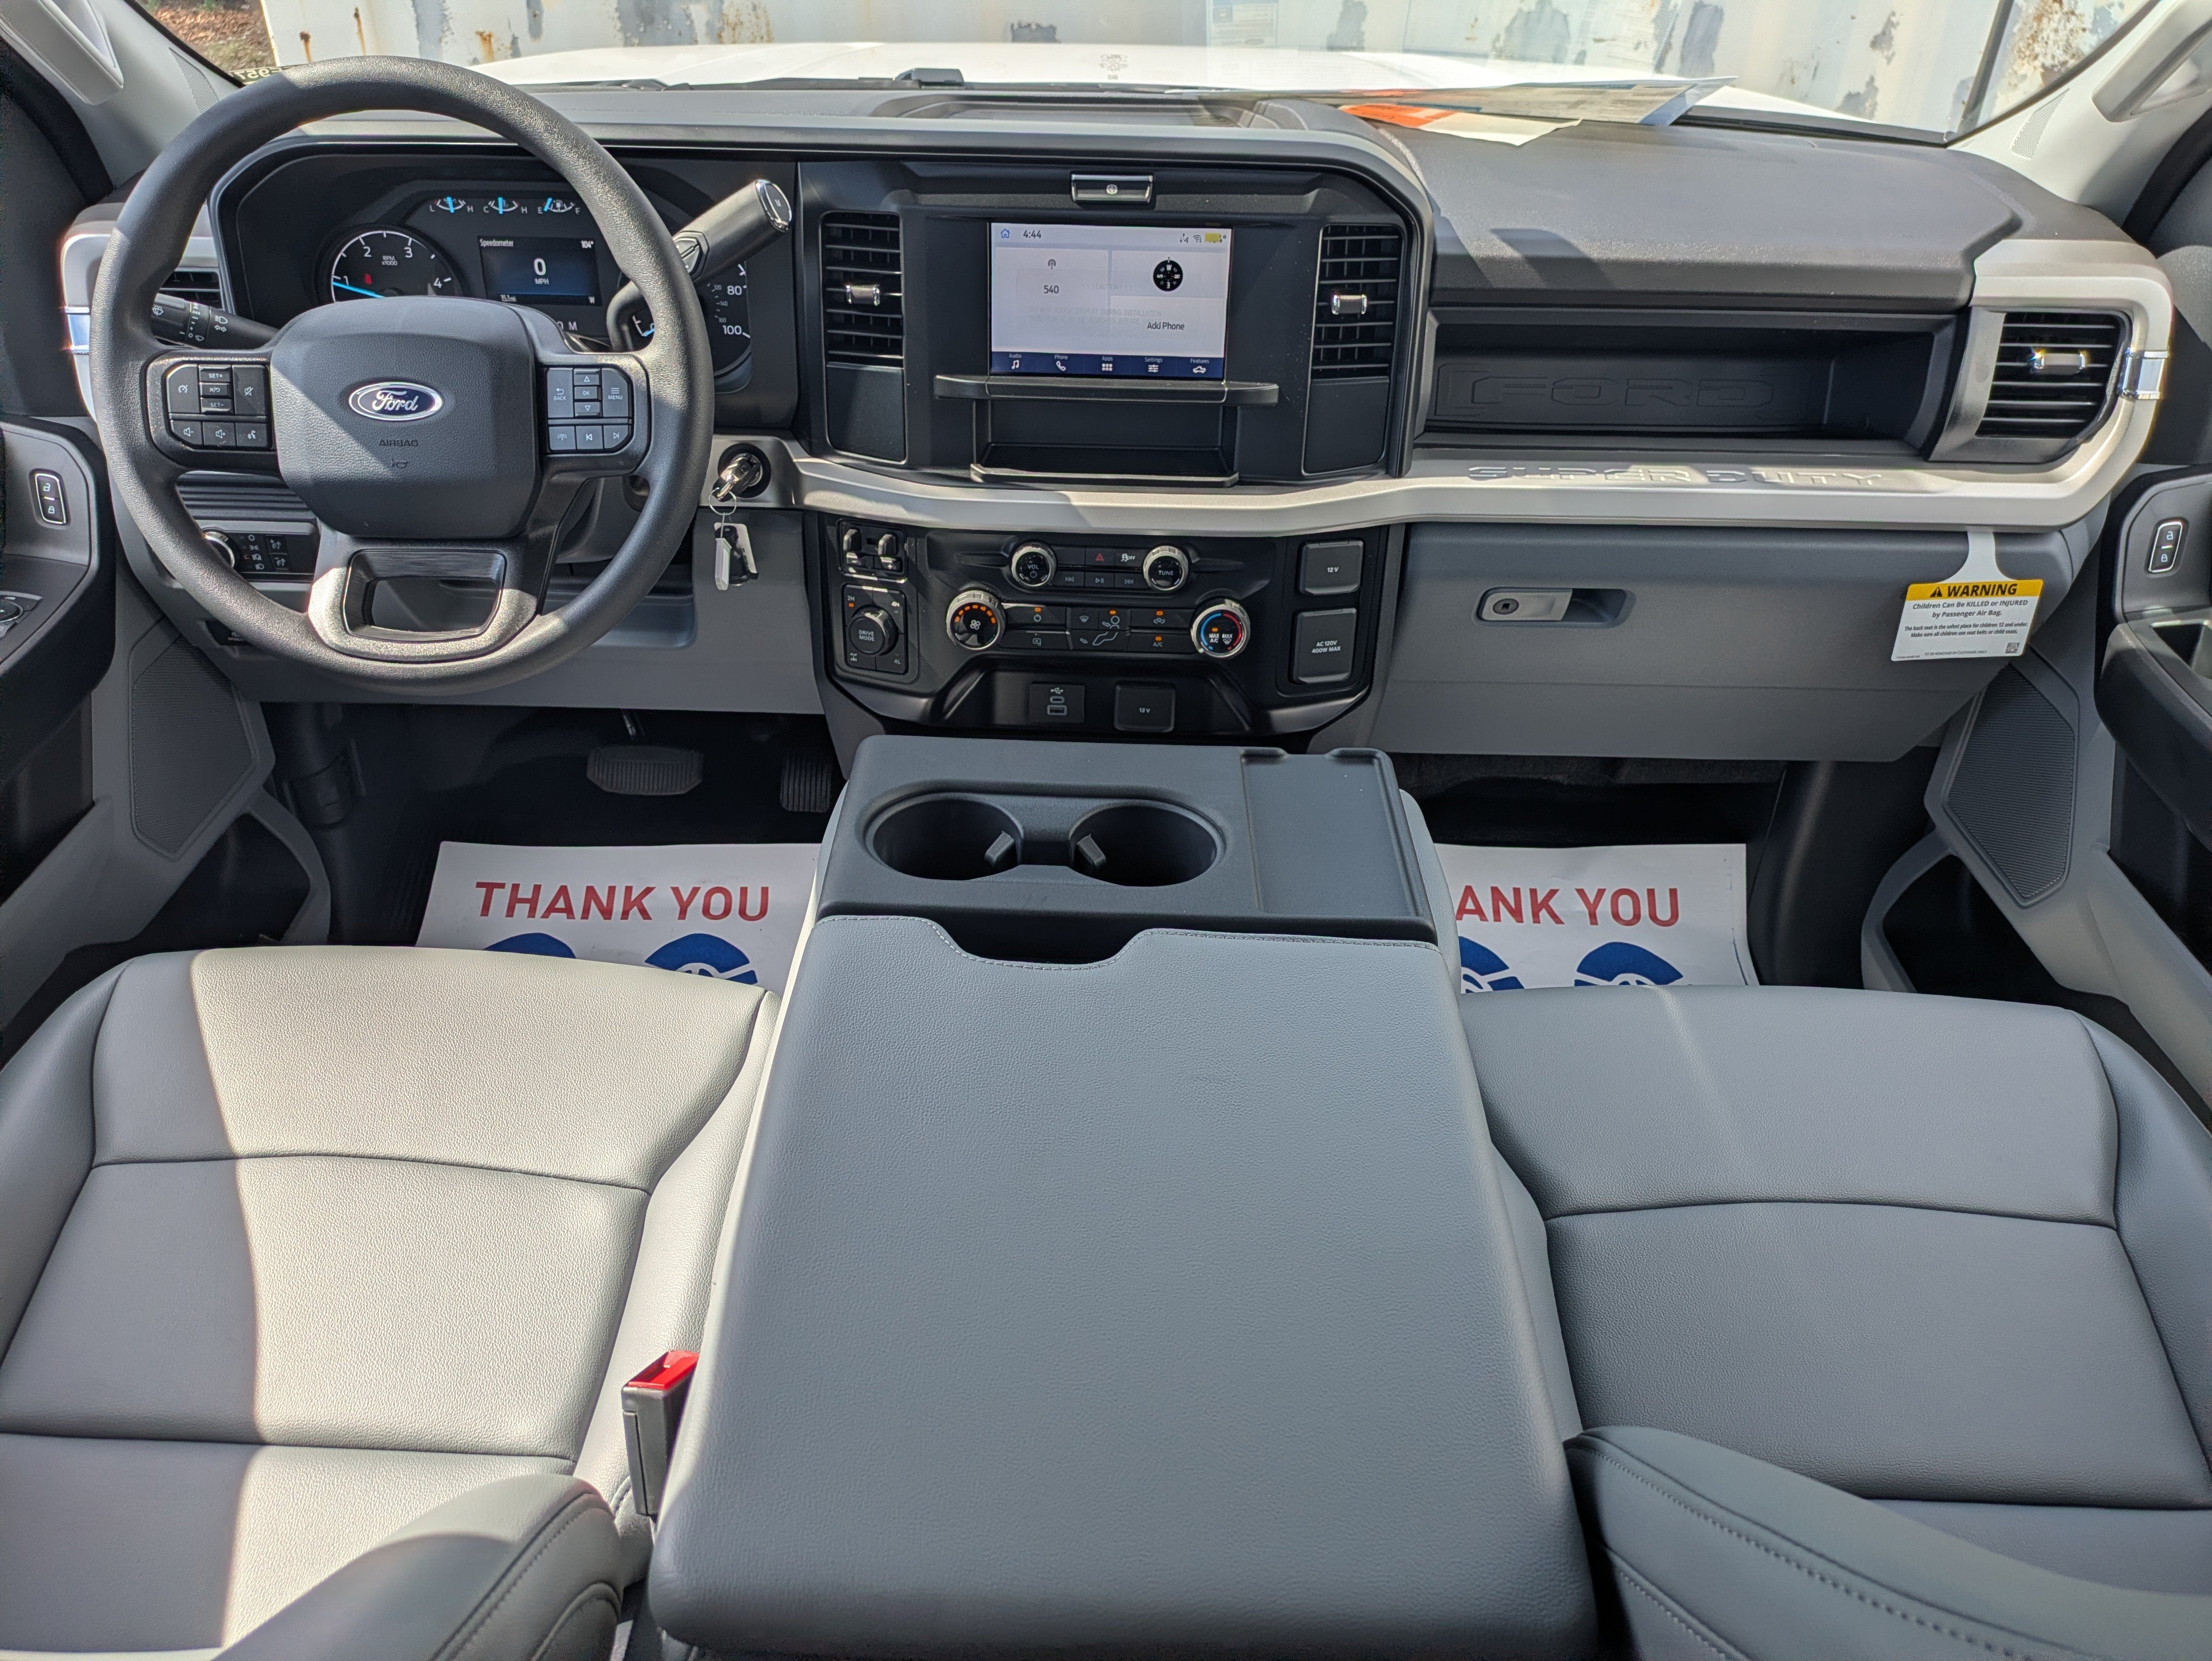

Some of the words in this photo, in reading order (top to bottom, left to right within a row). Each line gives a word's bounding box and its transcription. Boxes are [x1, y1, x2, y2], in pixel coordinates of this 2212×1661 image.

[1023, 230, 1042, 238] 4:44
[479, 239, 514, 247] Speedometer
[363, 246, 372, 257] 2
[404, 247, 412, 258] 3
[533, 258, 546, 276] 0
[343, 276, 349, 286] 1
[433, 277, 442, 288] 4
[727, 286, 742, 296] 80
[1043, 285, 1059, 294] 540
[722, 325, 742, 335] 100
[1162, 322, 1185, 330] Phone
[1471, 376, 1775, 407] FORD
[372, 390, 419, 411] Ford
[1468, 466, 1691, 481] SUPER
[1706, 470, 1882, 485] DUTY
[1947, 583, 2018, 598] WARNING
[475, 881, 656, 921] THANK
[670, 886, 770, 921] YOU
[1455, 885, 1565, 925] ANK
[1575, 887, 1680, 927] YOU
